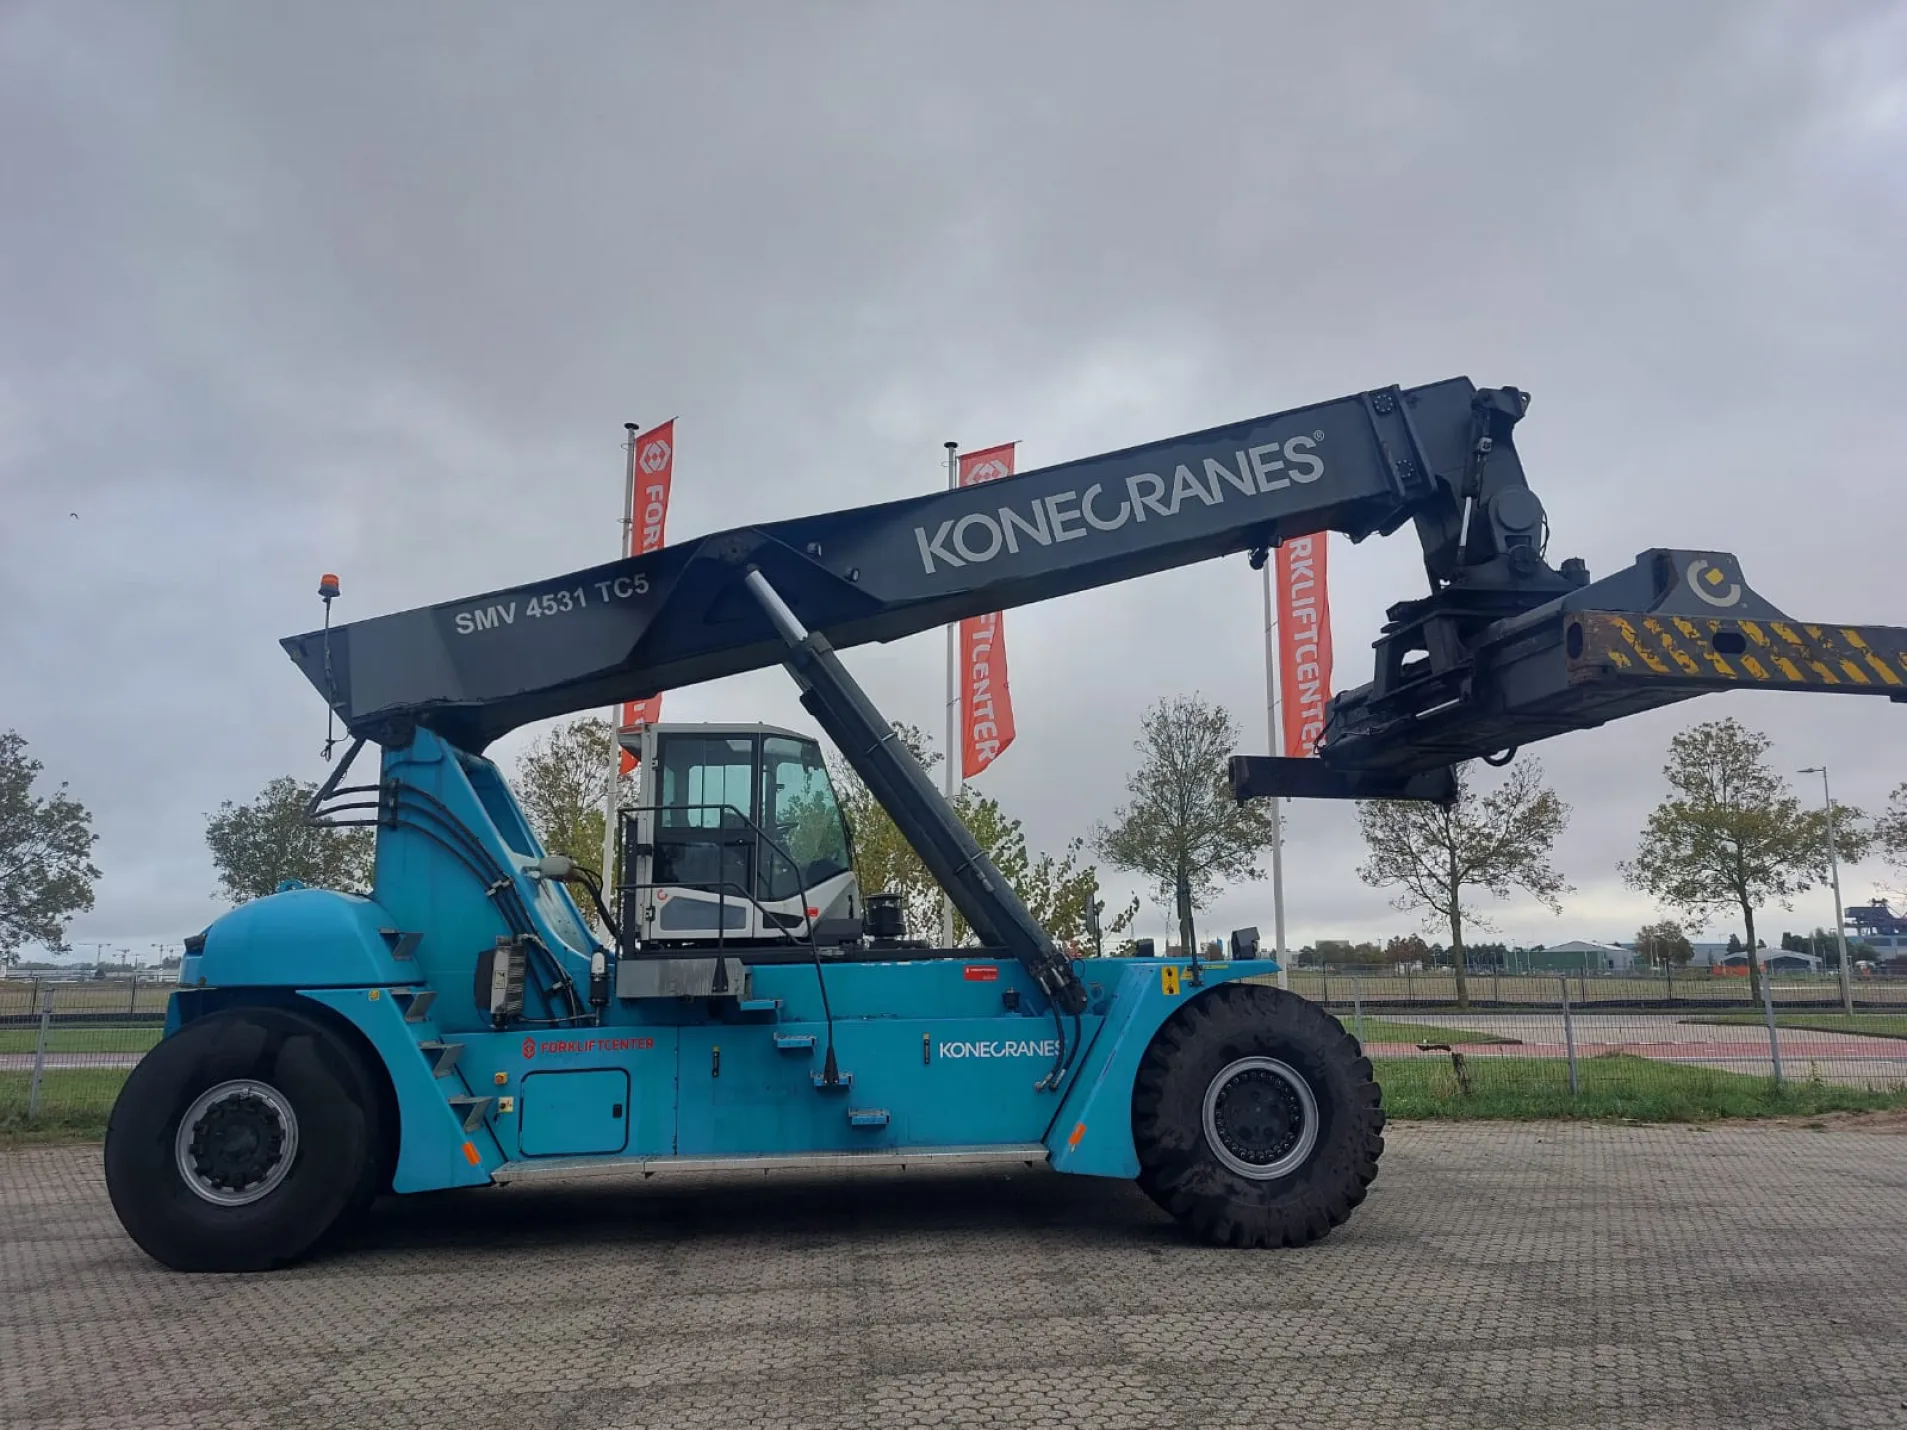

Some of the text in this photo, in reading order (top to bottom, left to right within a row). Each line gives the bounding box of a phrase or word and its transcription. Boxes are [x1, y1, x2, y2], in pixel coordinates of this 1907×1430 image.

[643, 485, 664, 553] FOR
[455, 573, 650, 635] SMV 4531 TC5
[541, 1037, 655, 1054] FORKLIFTCENTER
